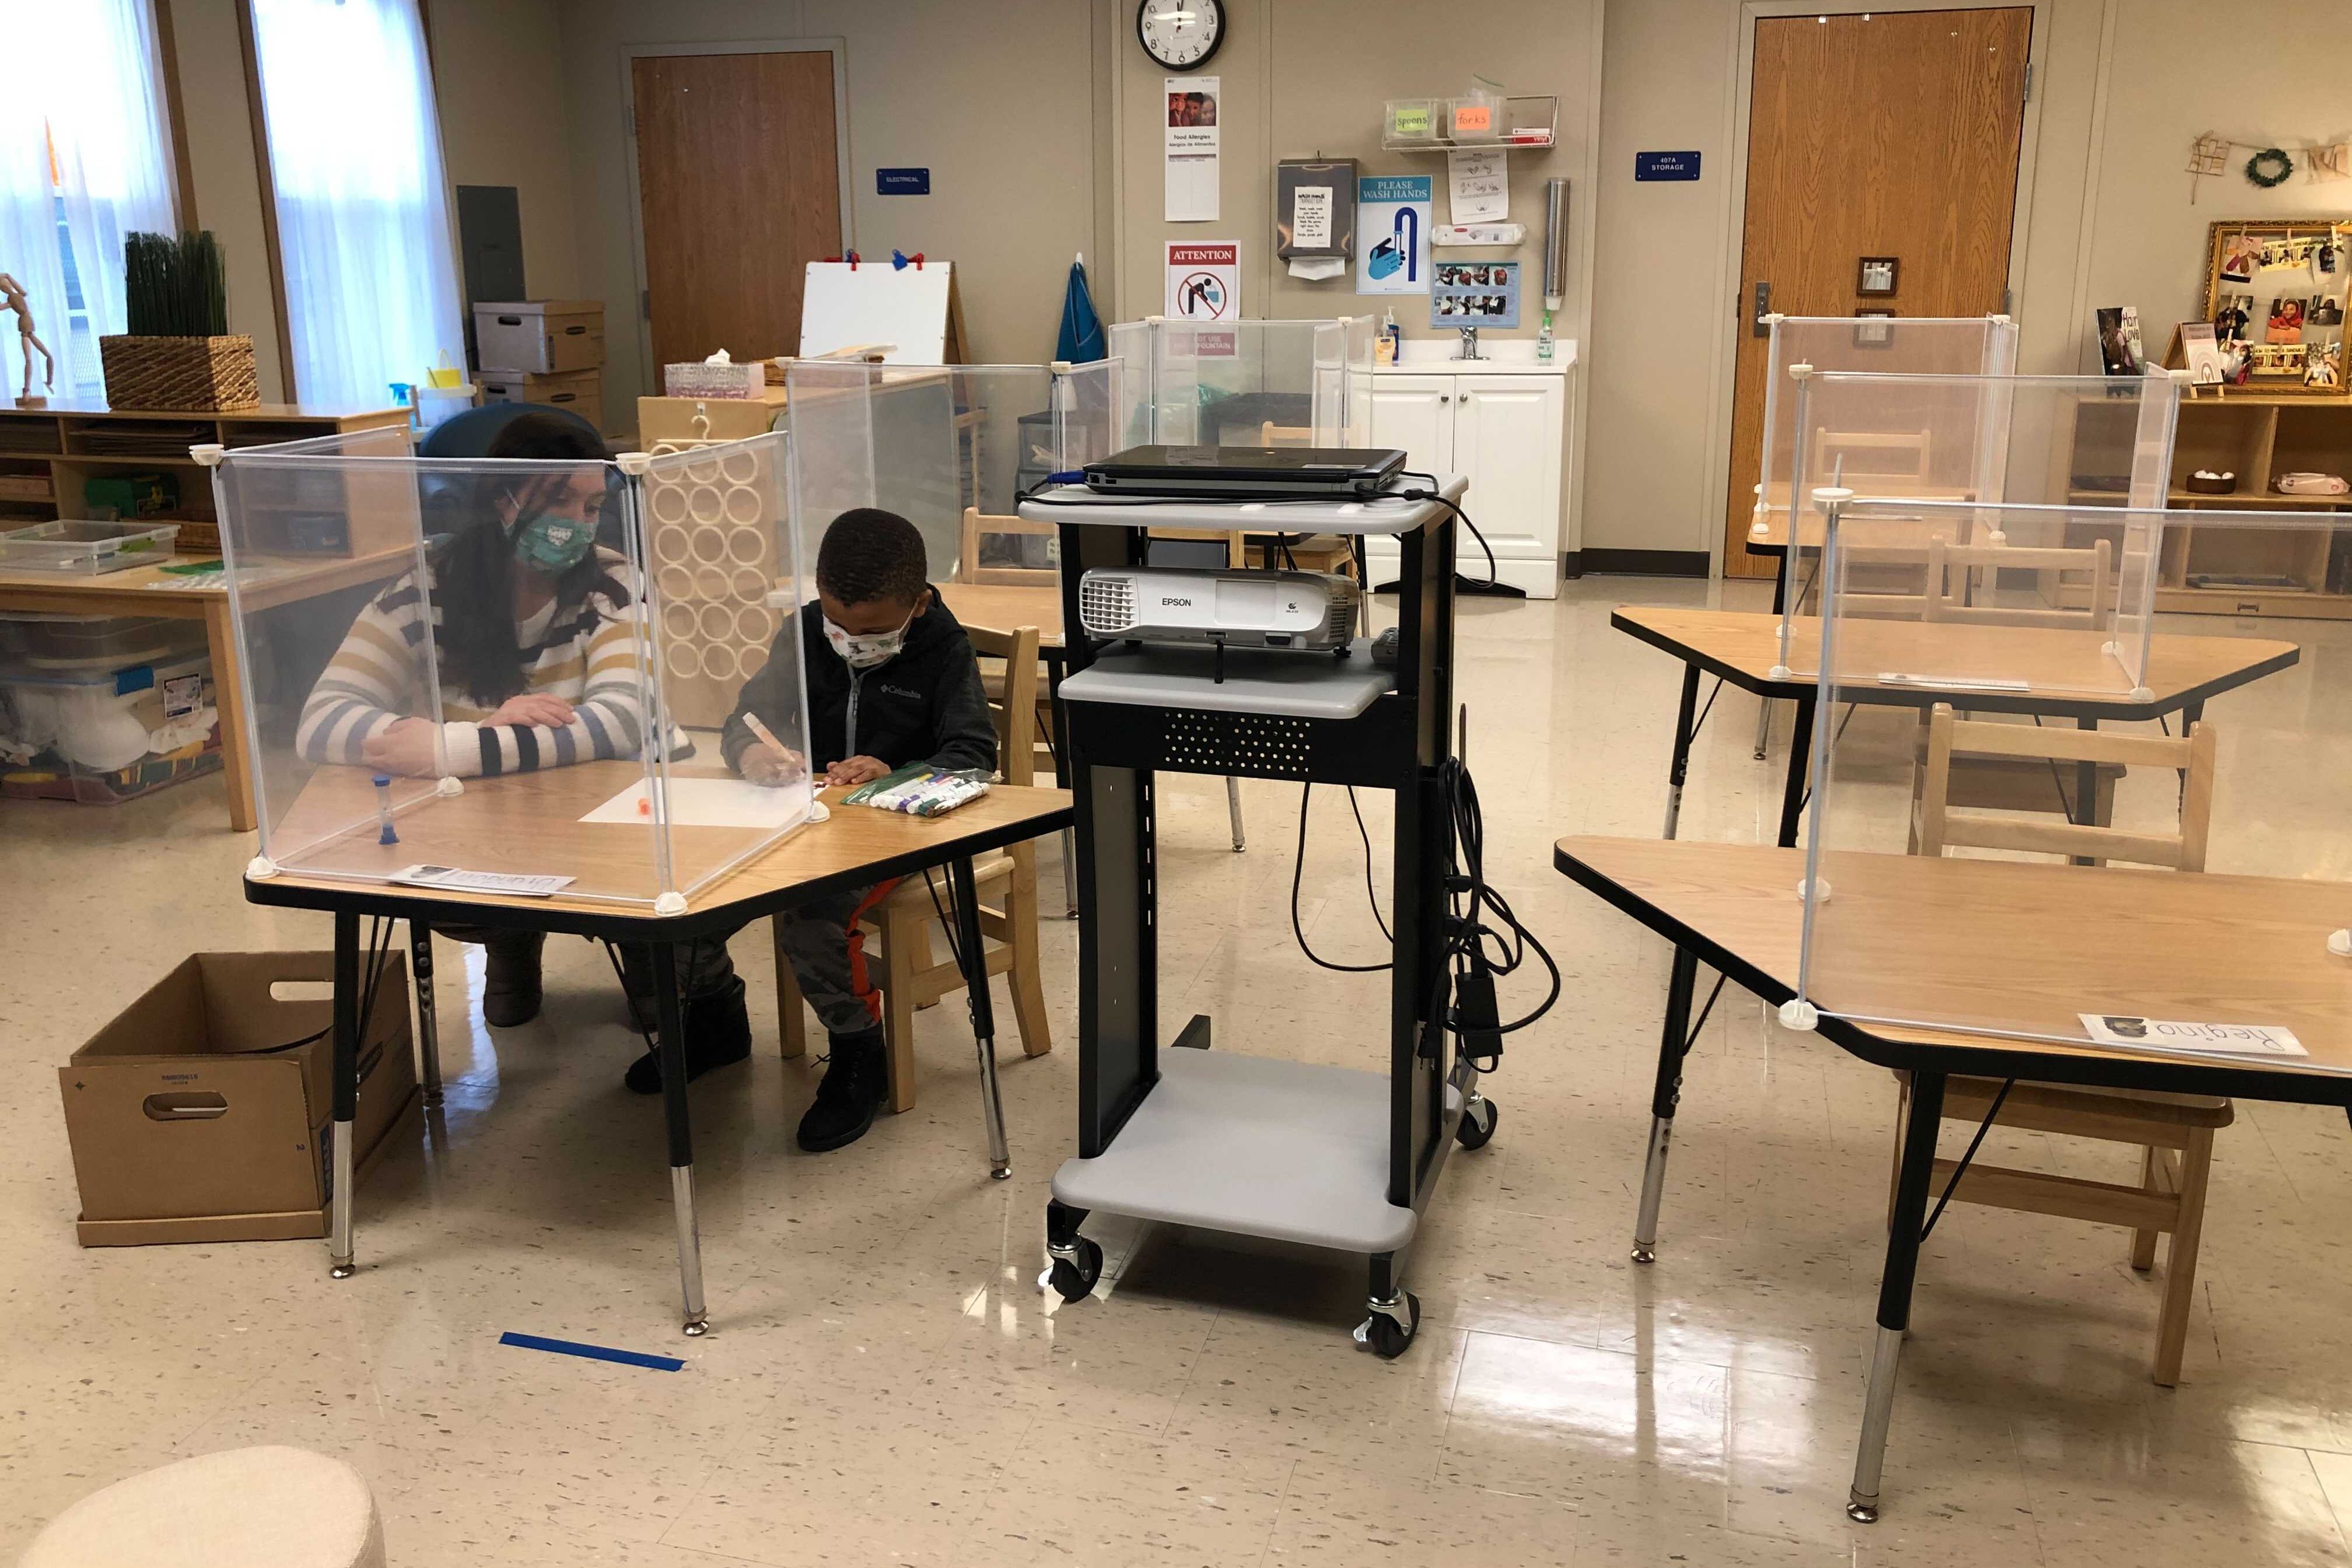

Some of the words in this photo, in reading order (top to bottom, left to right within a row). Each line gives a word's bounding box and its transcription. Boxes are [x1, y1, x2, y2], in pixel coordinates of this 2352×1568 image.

[1148, 5, 1156, 14] 10
[1209, 15, 1214, 24] 3
[1145, 22, 1152, 31] 9
[1205, 32, 1210, 41] 4
[1150, 38, 1157, 49] 8
[1163, 51, 1168, 60] 7
[1178, 52, 1185, 62] 6
[1194, 47, 1200, 57] 5
[1377, 180, 1413, 190] PLEASE
[1363, 190, 1391, 198] WASH
[1393, 189, 1428, 198] HANDS
[1173, 250, 1232, 260] ATTENTION
[2122, 312, 2137, 328] Hair
[2124, 328, 2140, 343] Love
[1162, 598, 1191, 607] EPSON
[888, 685, 921, 699] Columbia
